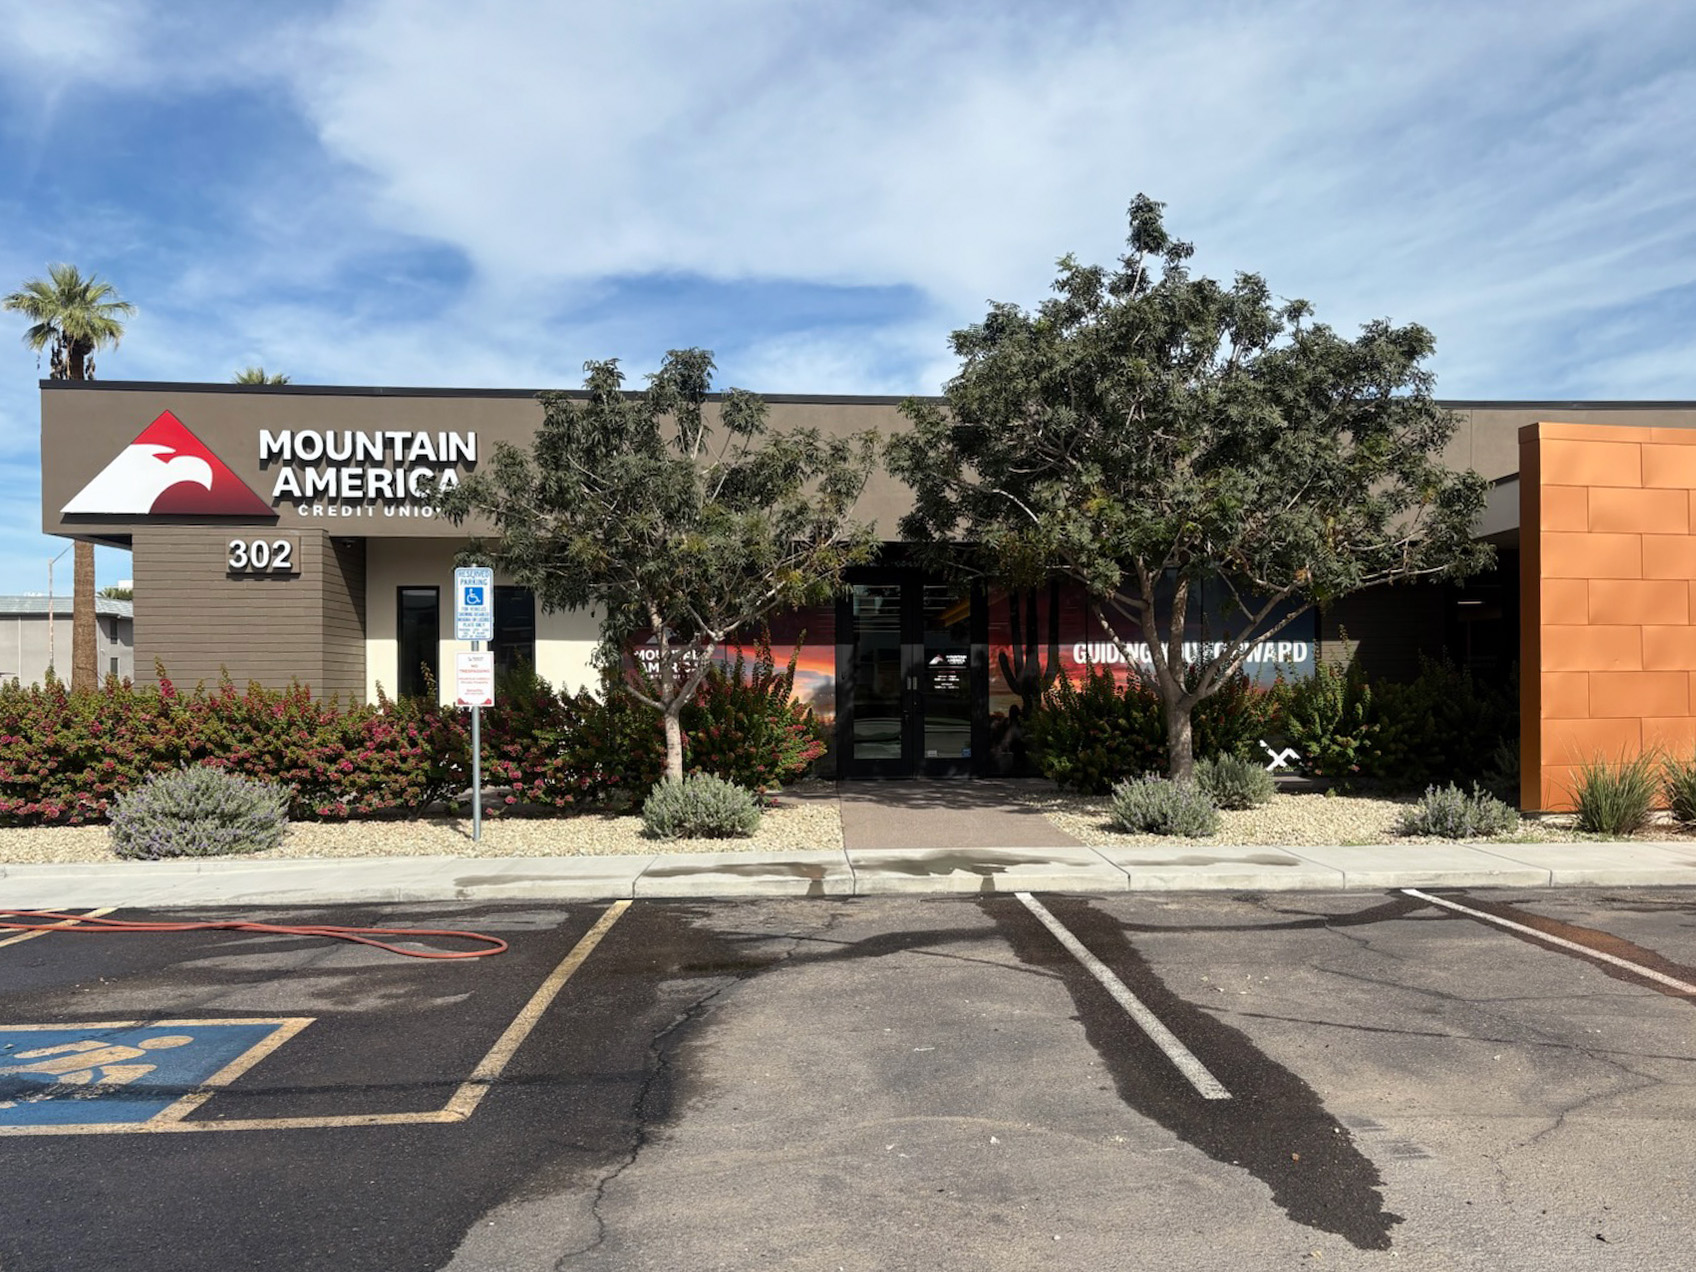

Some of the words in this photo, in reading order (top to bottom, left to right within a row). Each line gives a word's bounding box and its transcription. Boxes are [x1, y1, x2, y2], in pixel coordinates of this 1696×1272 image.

[259, 429, 476, 461] MOUNTAIN
[298, 503, 375, 517] CREDIT
[384, 505, 446, 518] UNIO
[228, 539, 292, 569] 302
[458, 570, 489, 578] RESERVED
[460, 578, 488, 586] PARKING
